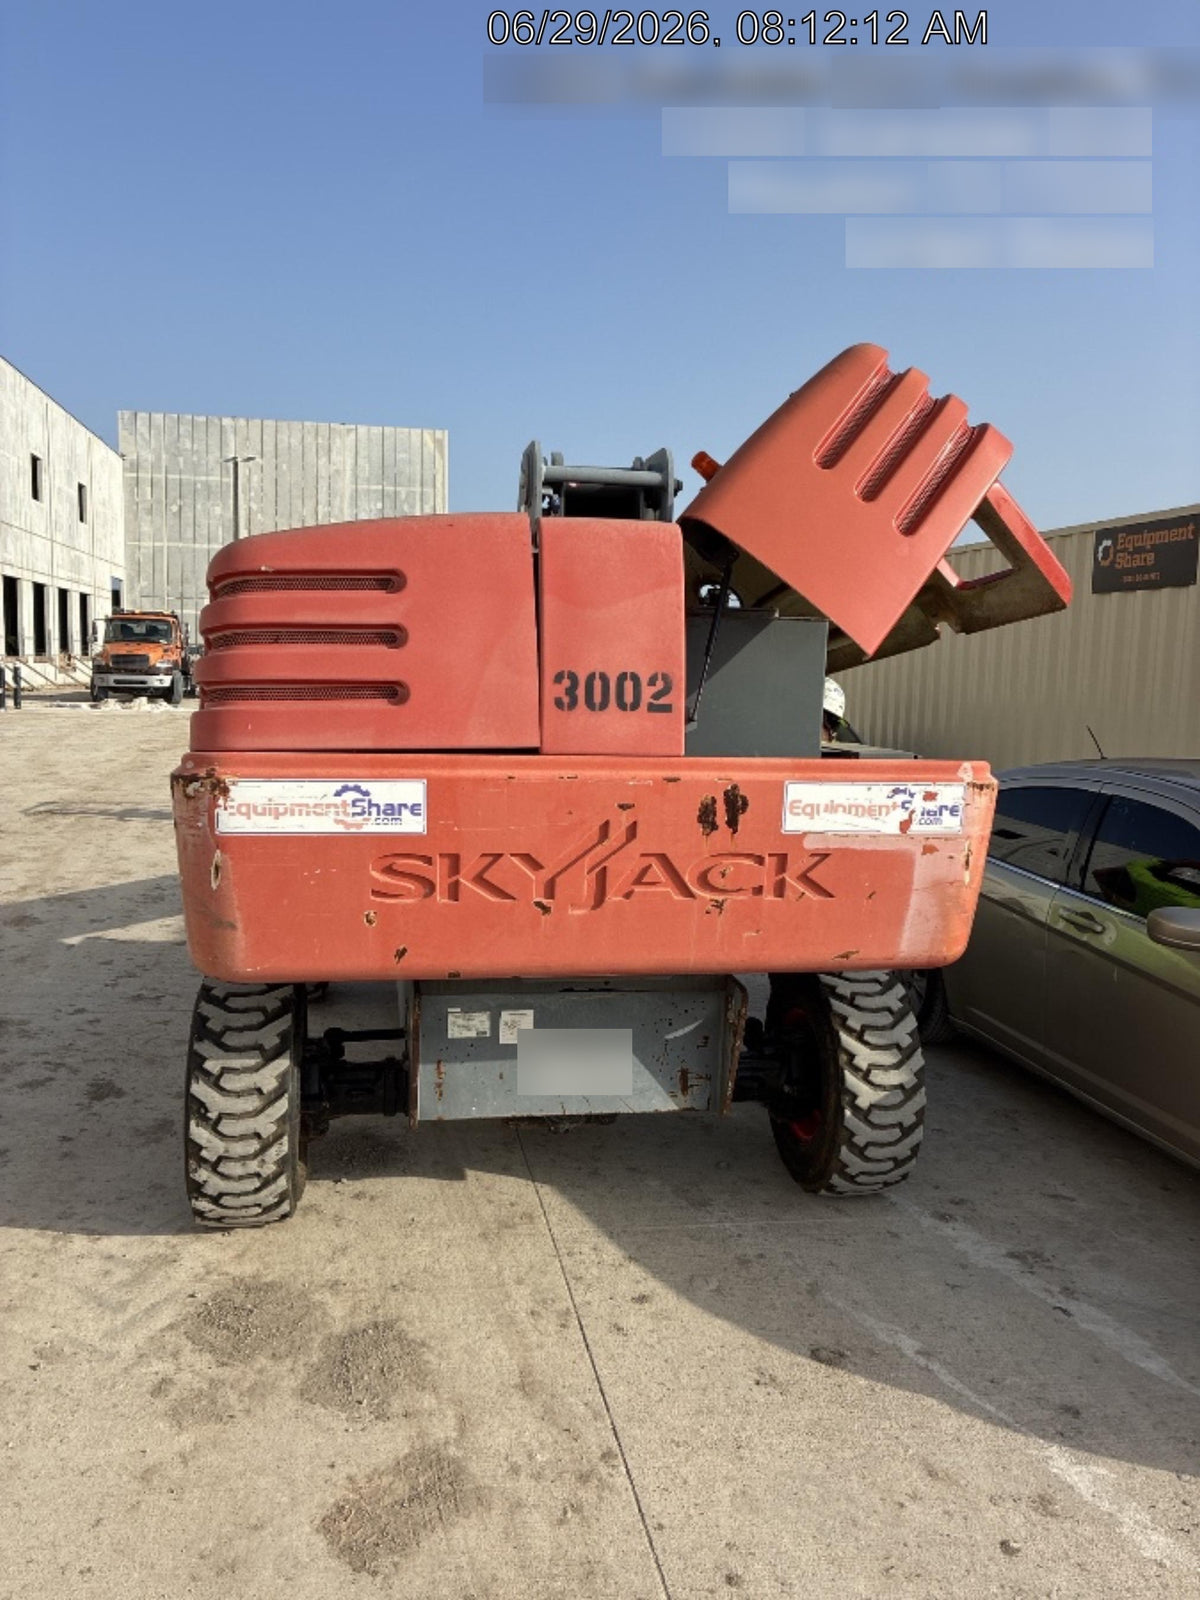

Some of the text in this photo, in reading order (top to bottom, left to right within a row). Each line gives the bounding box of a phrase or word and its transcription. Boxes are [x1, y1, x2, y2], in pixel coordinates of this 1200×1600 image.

[1117, 522, 1195, 551] Equipment
[1115, 551, 1155, 569] Share
[553, 670, 673, 713] 3002
[368, 818, 837, 915] SKYJACK
